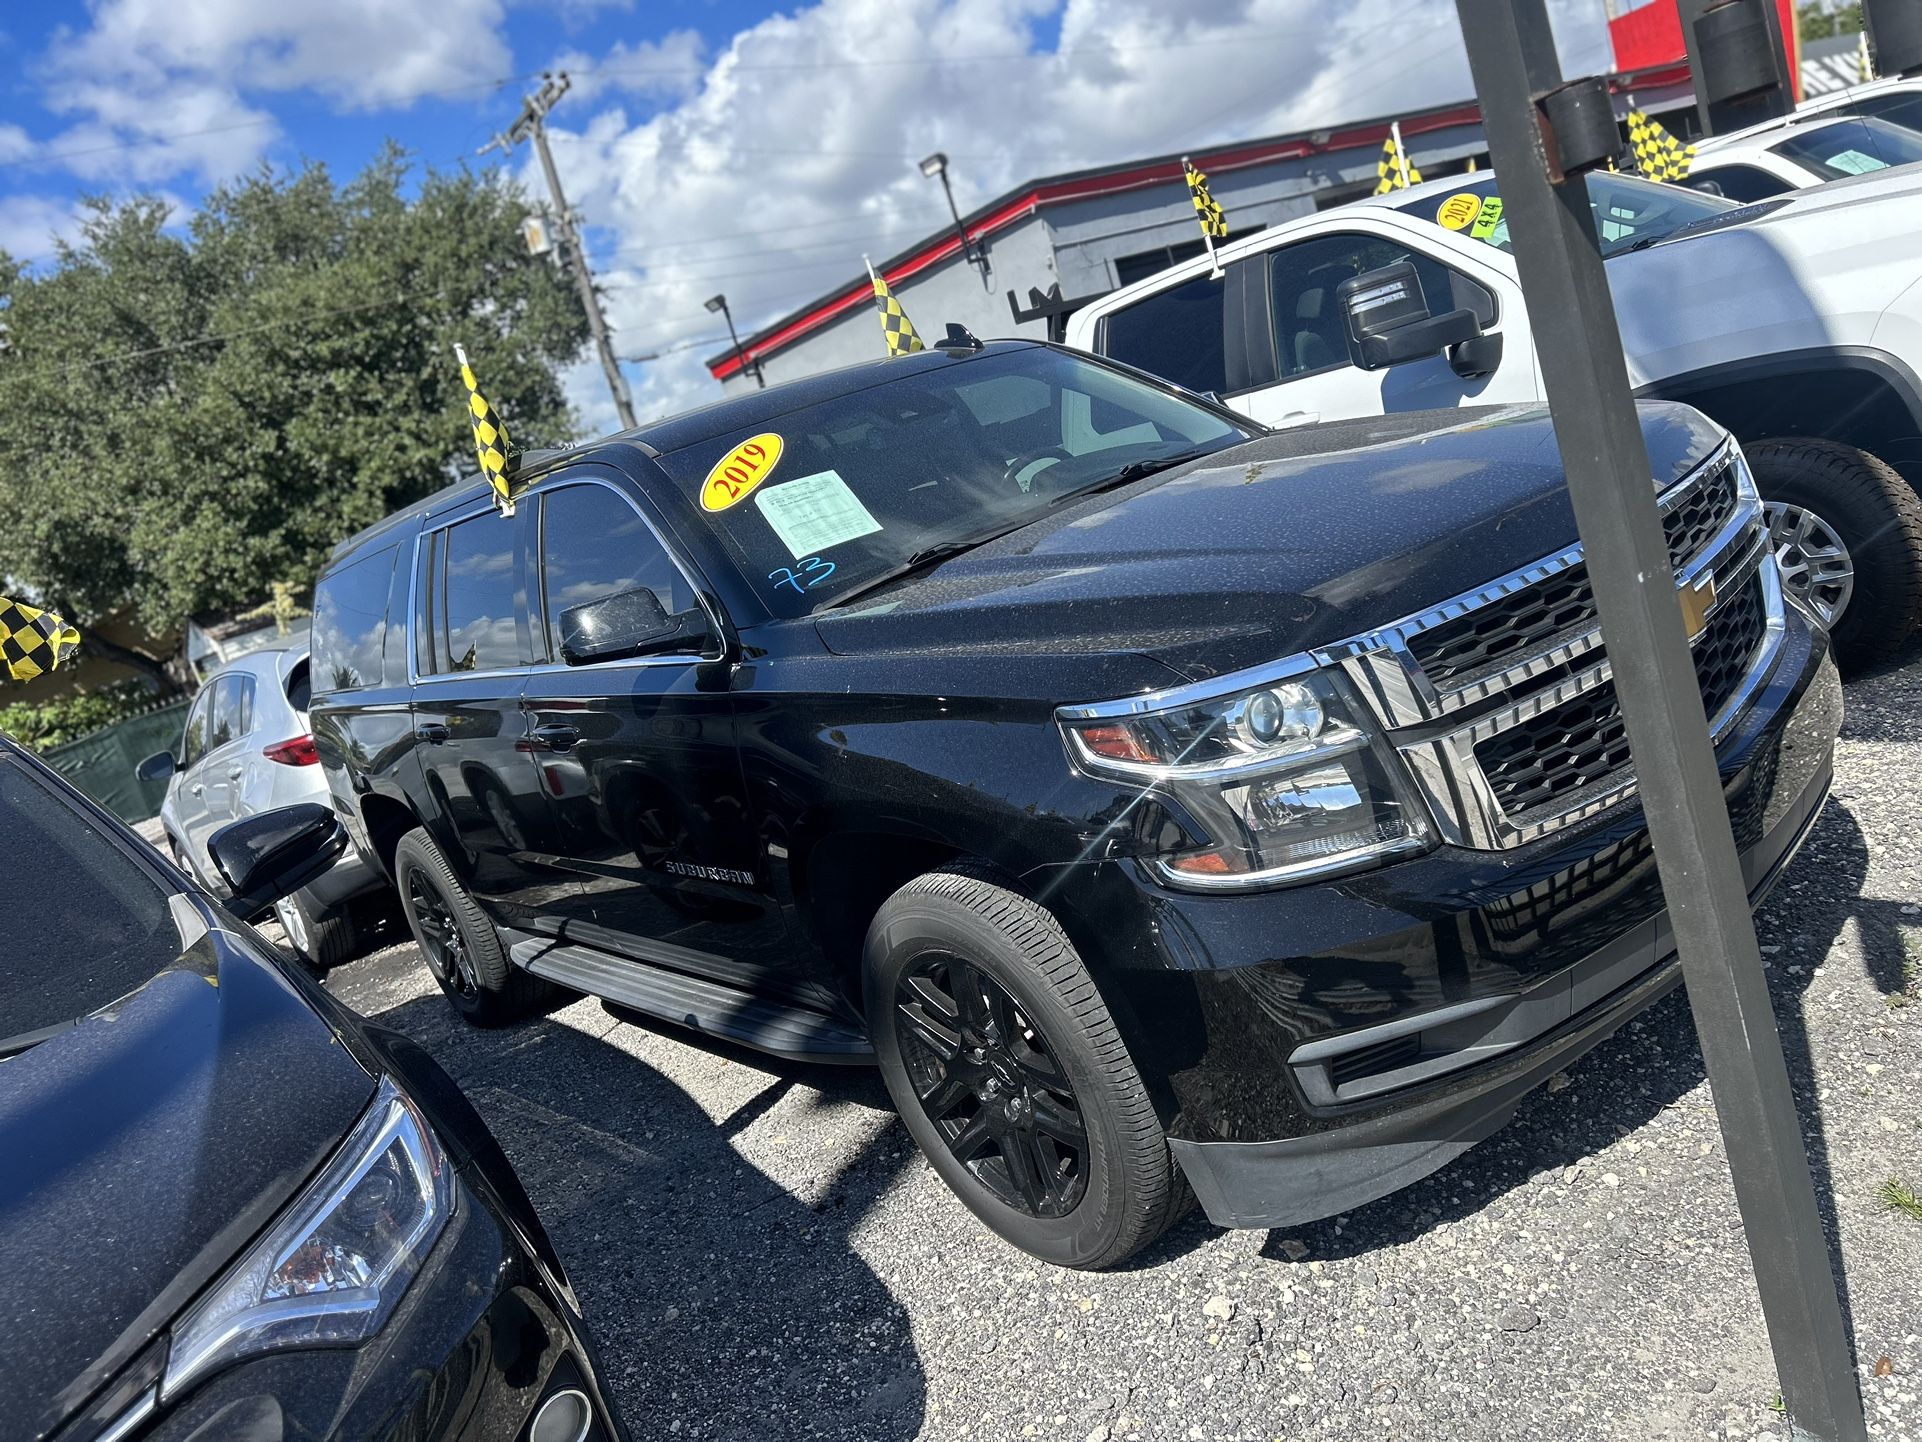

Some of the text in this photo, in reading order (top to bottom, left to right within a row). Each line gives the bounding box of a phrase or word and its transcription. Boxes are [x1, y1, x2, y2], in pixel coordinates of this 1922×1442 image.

[1445, 198, 1474, 223] 2021
[713, 443, 766, 500] 2019
[767, 556, 836, 594] 73
[665, 860, 755, 886] SUBURBAN
[1091, 1118, 1110, 1232] PATHFINDER HT
